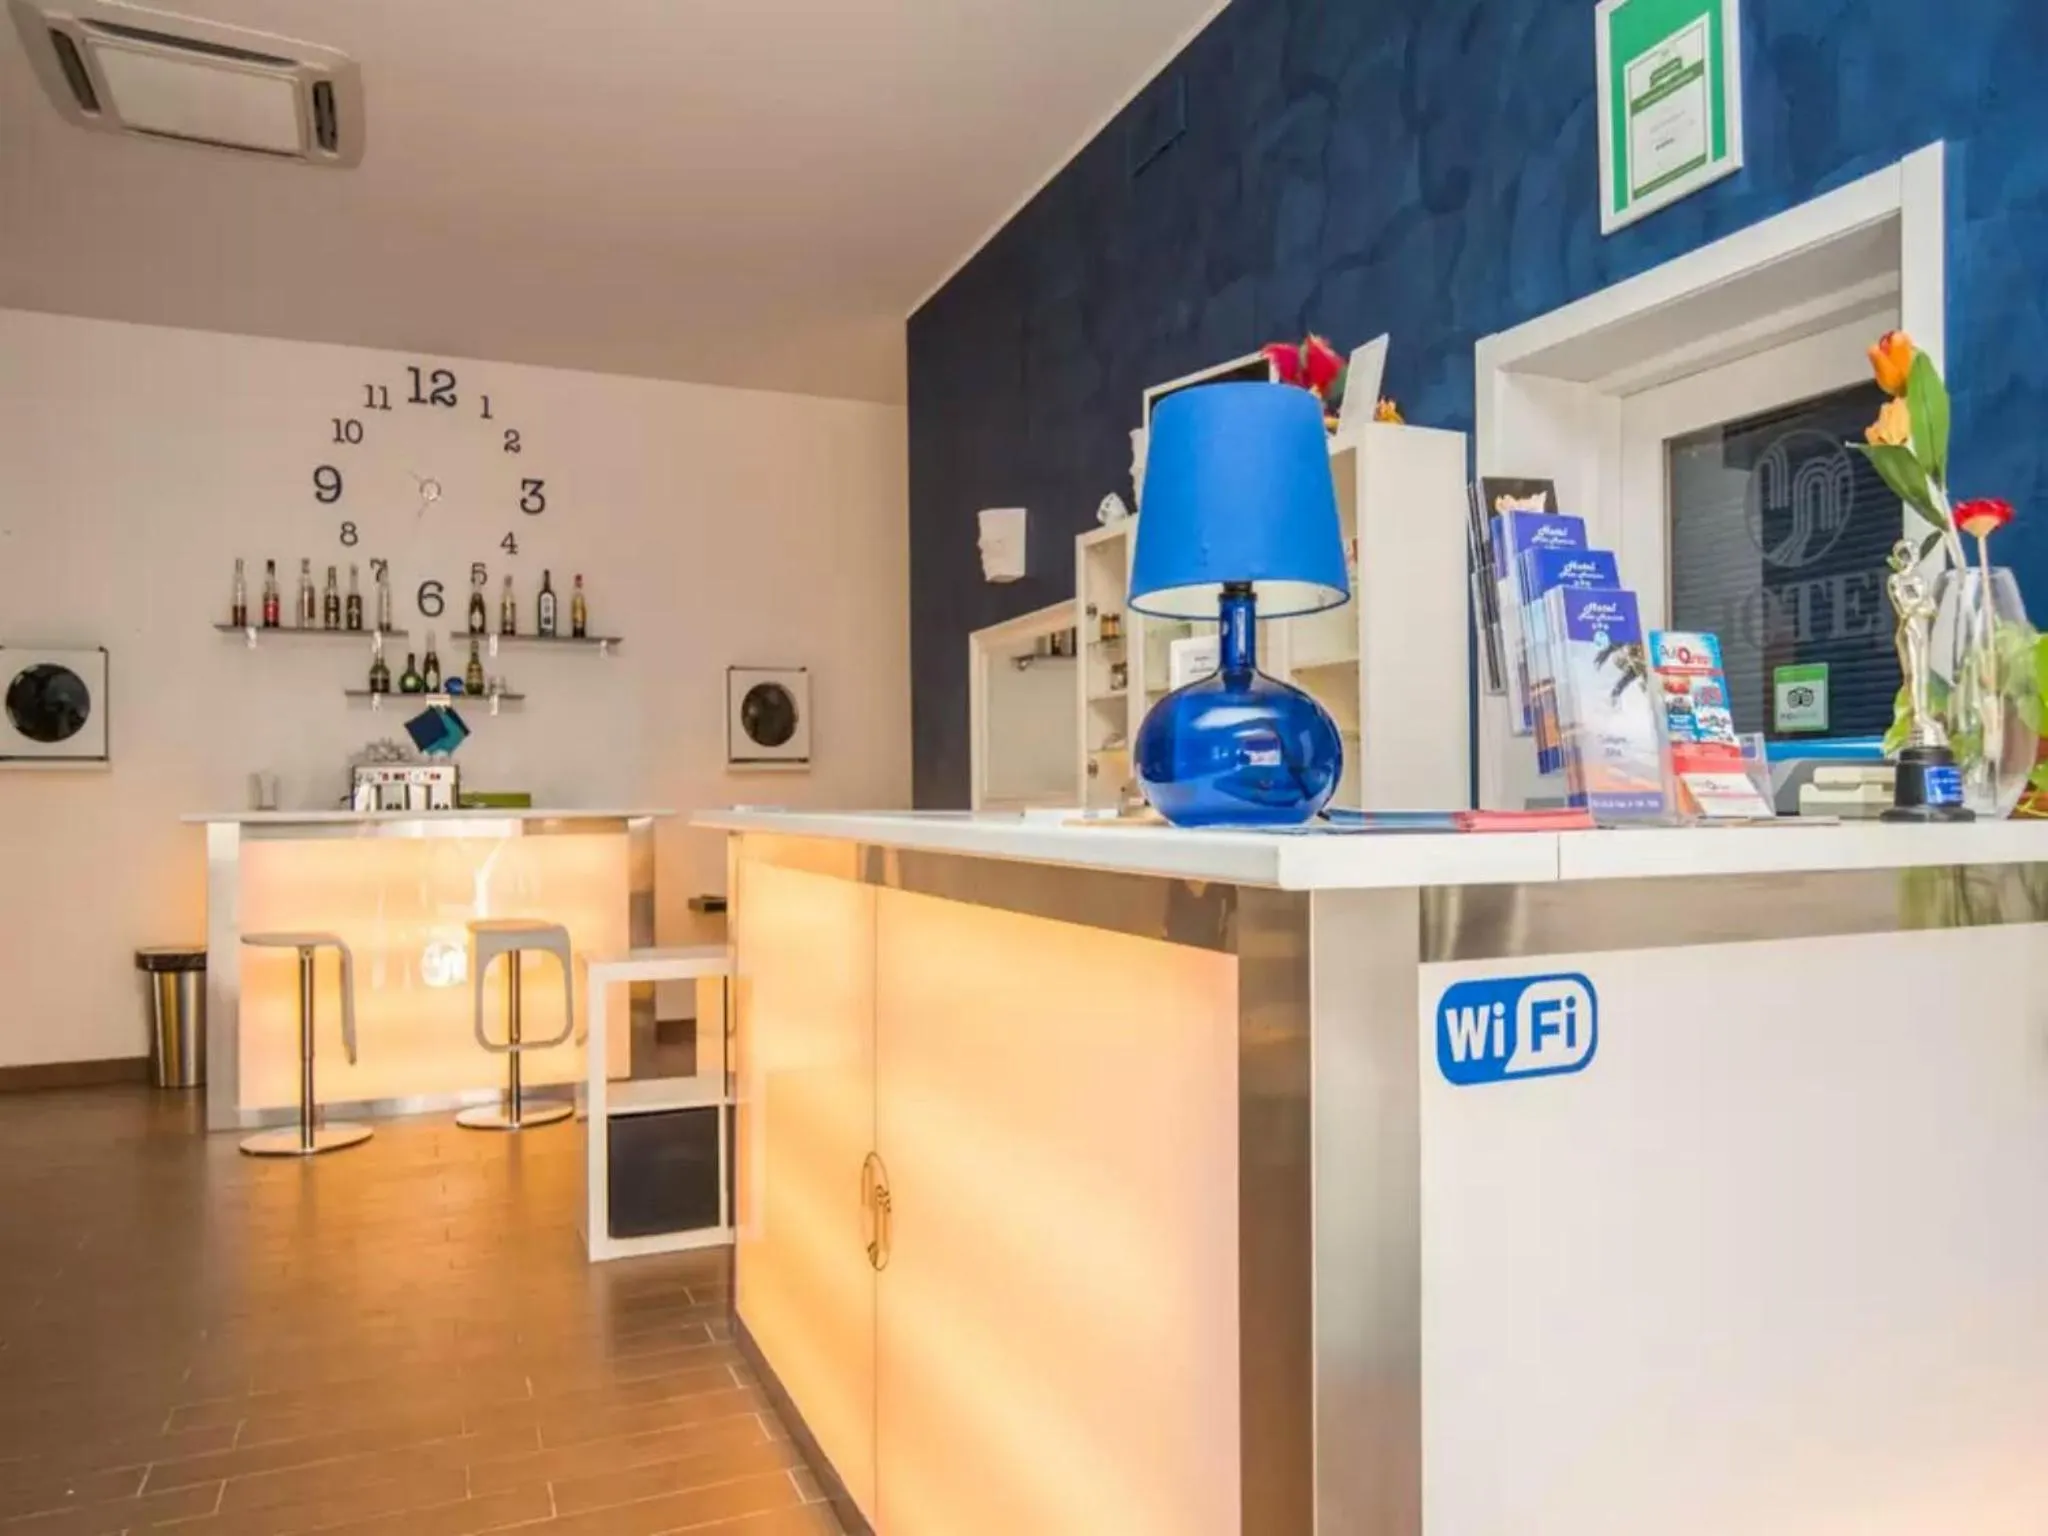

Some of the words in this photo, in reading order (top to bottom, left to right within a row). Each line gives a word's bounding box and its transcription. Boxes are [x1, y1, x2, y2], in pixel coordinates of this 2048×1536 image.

[364, 384, 392, 411] 11
[406, 366, 457, 408] 12
[480, 395, 493, 420] 1
[332, 418, 364, 445] 10
[503, 429, 522, 454] 2
[313, 465, 342, 503] 9
[519, 478, 546, 515] 3
[340, 521, 359, 546] 8
[500, 532, 518, 555] 4
[370, 559, 388, 584] 7
[470, 562, 488, 586] 5
[417, 580, 445, 618] 6
